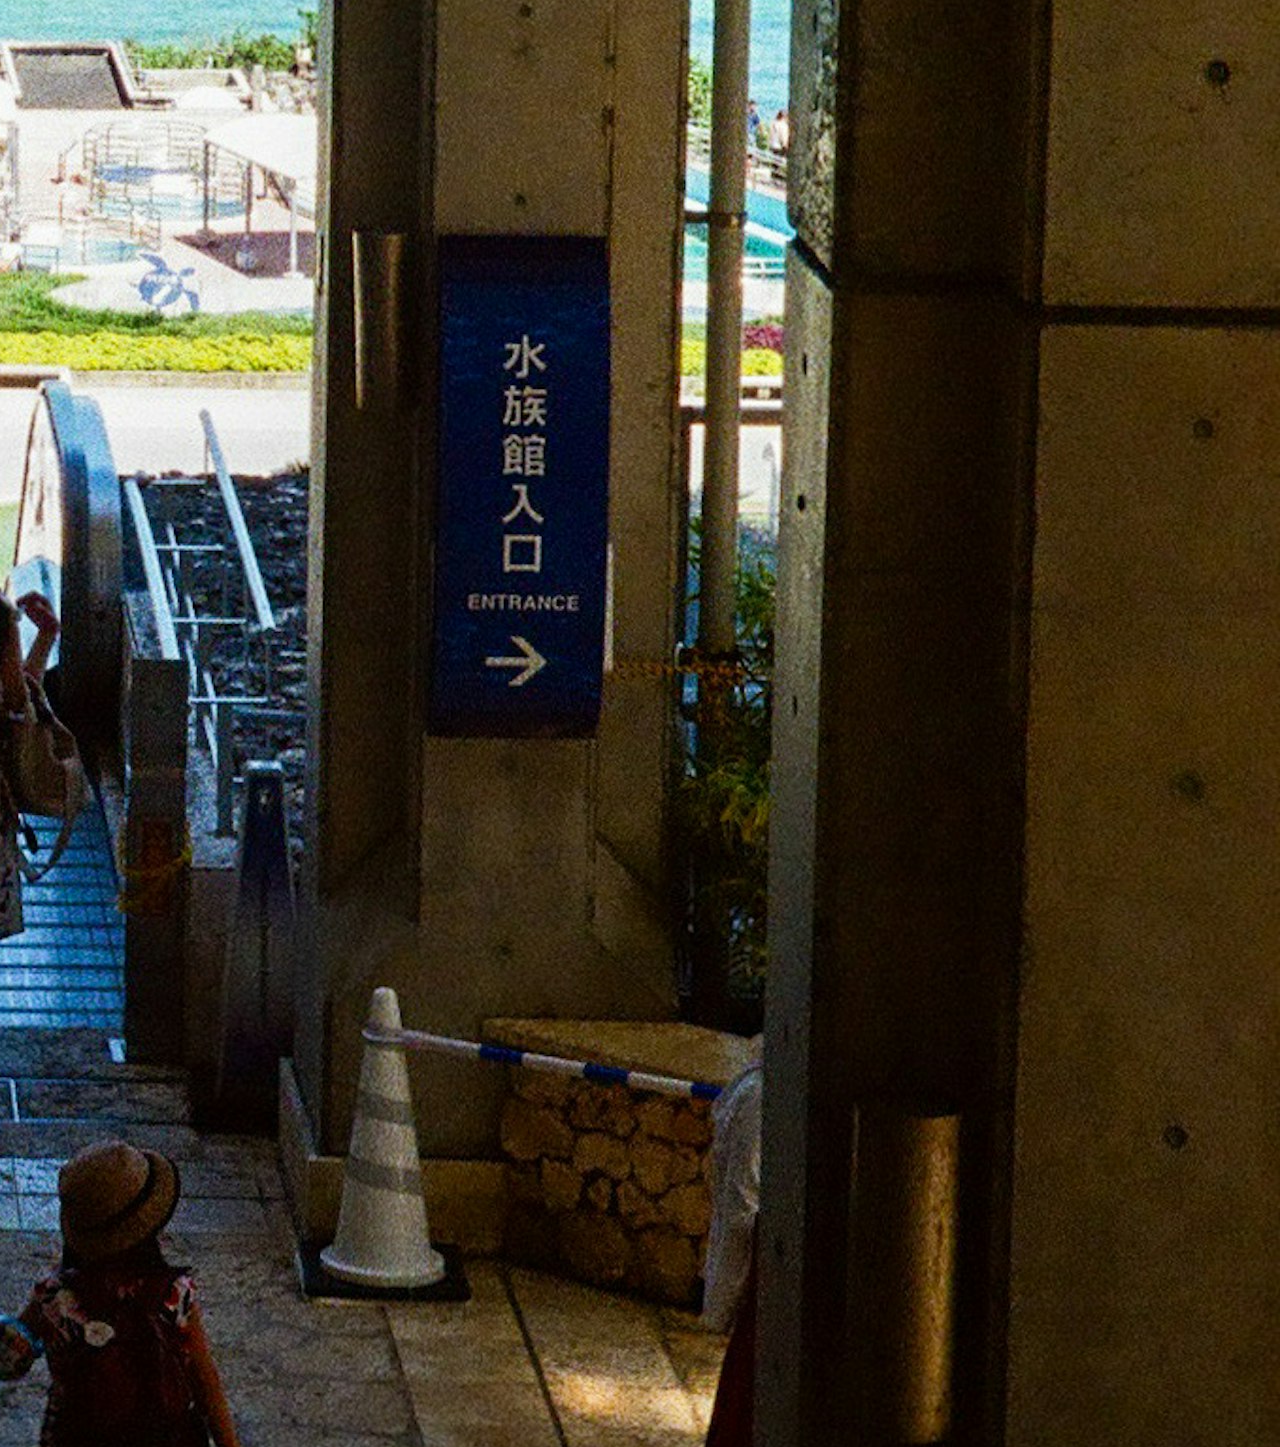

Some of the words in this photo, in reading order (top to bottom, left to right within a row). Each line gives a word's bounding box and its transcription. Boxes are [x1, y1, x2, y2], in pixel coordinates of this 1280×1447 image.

[502, 334, 548, 573] 水族館入口
[467, 593, 579, 611] ENTRANCE
